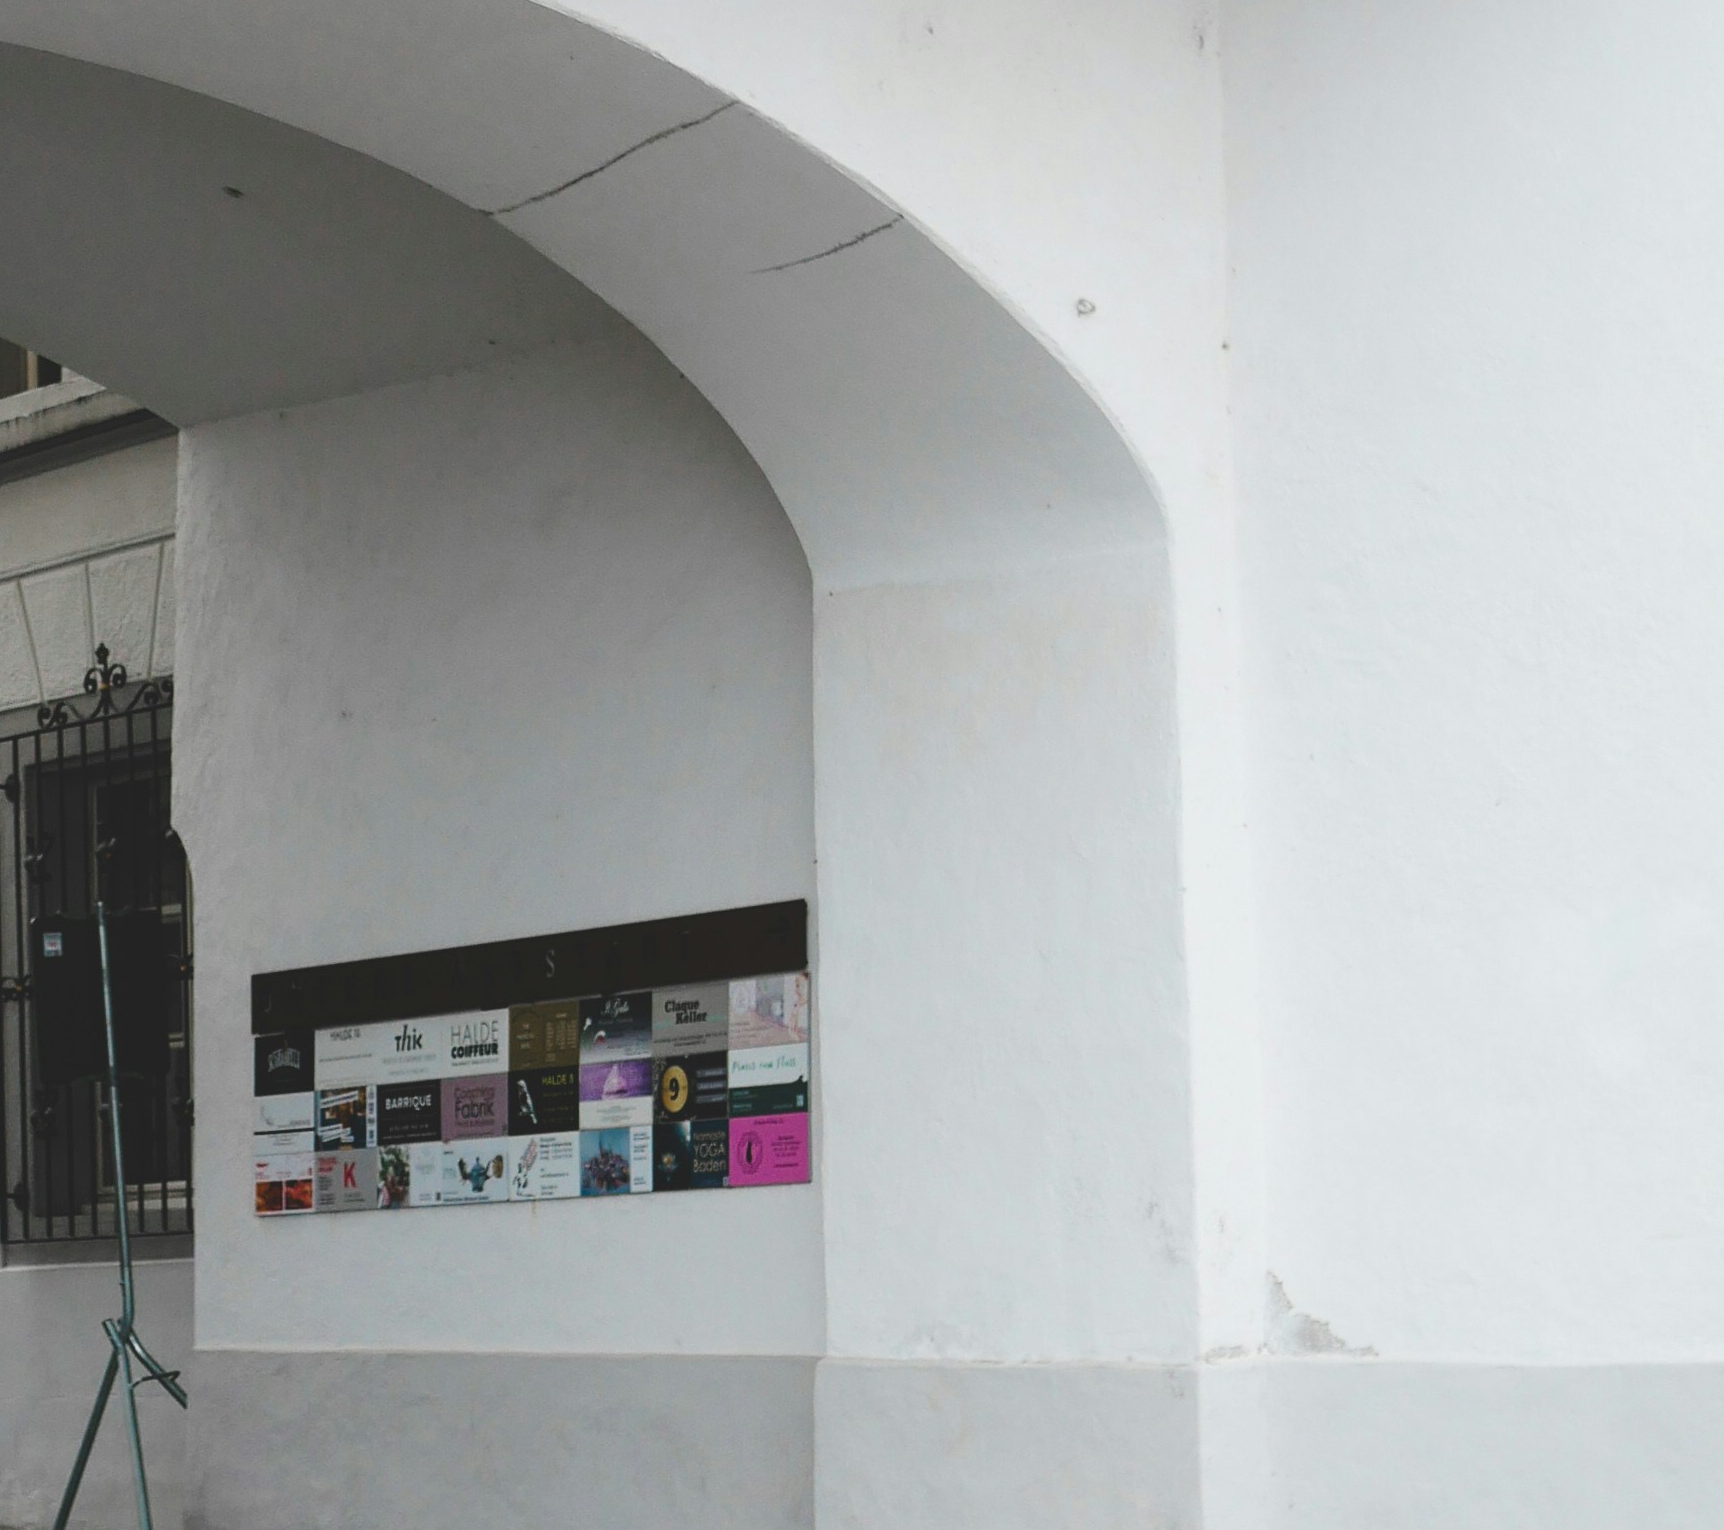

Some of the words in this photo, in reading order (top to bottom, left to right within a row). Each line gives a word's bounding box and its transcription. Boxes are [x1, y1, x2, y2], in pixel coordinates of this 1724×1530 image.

[664, 999, 700, 1013] Claque
[675, 1011, 708, 1025] Keller
[450, 1020, 500, 1047] HALDE
[450, 1042, 500, 1059] COIFFEUR
[669, 1077, 679, 1101] 9
[384, 1094, 433, 1111] BARRIQUE
[693, 1142, 725, 1158] YOGA
[693, 1158, 726, 1174] Baden
[343, 1161, 358, 1189] K
